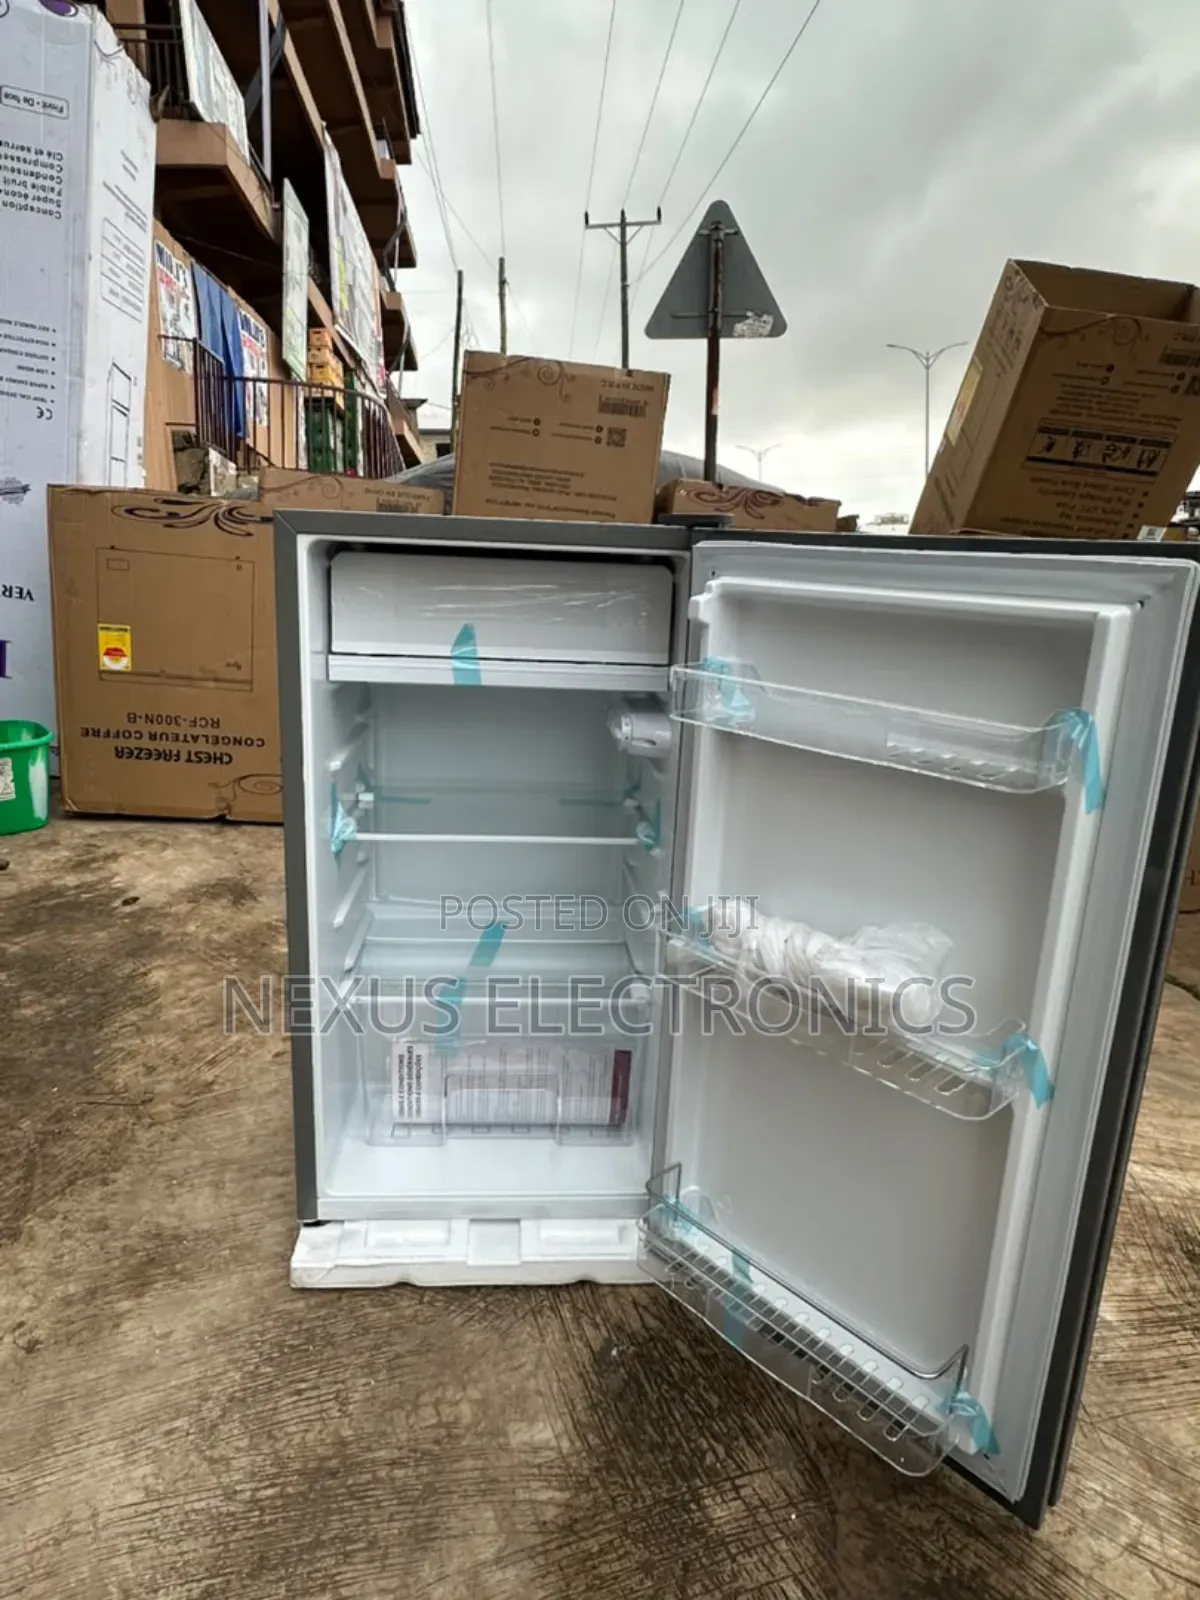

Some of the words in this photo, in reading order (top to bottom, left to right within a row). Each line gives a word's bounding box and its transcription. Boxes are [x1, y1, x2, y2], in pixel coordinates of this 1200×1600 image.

[0, 165, 63, 185] Condenseu
[4, 176, 28, 190] bruit
[31, 182, 63, 197] Faible
[32, 195, 62, 208] Super
[2, 200, 62, 220] Conception
[0, 584, 34, 602] VER
[126, 712, 220, 729] RCF-300N-B
[80, 727, 143, 742] COFFRE
[114, 746, 181, 762] FREEZER
[184, 748, 233, 766] CHEST
